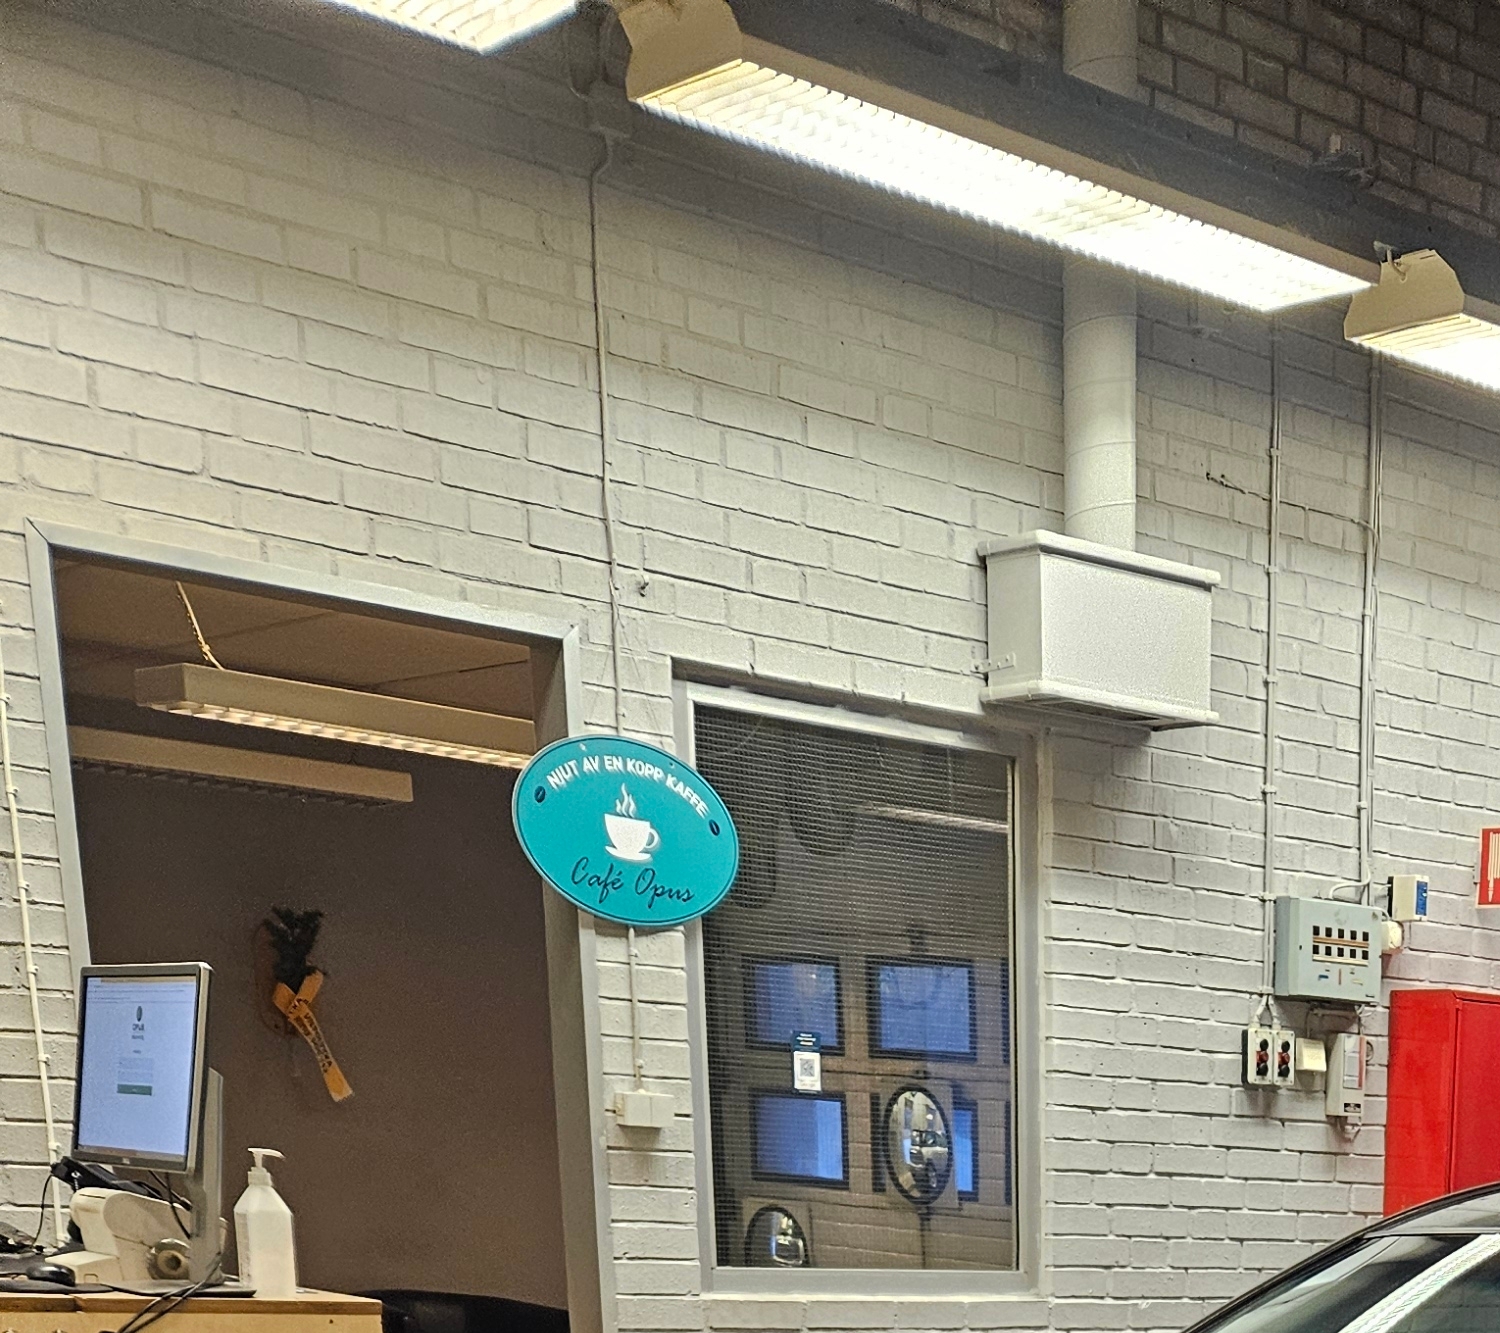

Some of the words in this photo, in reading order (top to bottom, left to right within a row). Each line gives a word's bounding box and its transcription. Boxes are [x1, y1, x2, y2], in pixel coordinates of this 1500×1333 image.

[547, 760, 579, 789] NJUT
[583, 755, 600, 772] AV
[604, 756, 623, 773] EN
[626, 757, 665, 782] KOPP
[665, 774, 710, 819] KAFFE
[571, 856, 624, 904] Café
[635, 867, 695, 909] Opus
